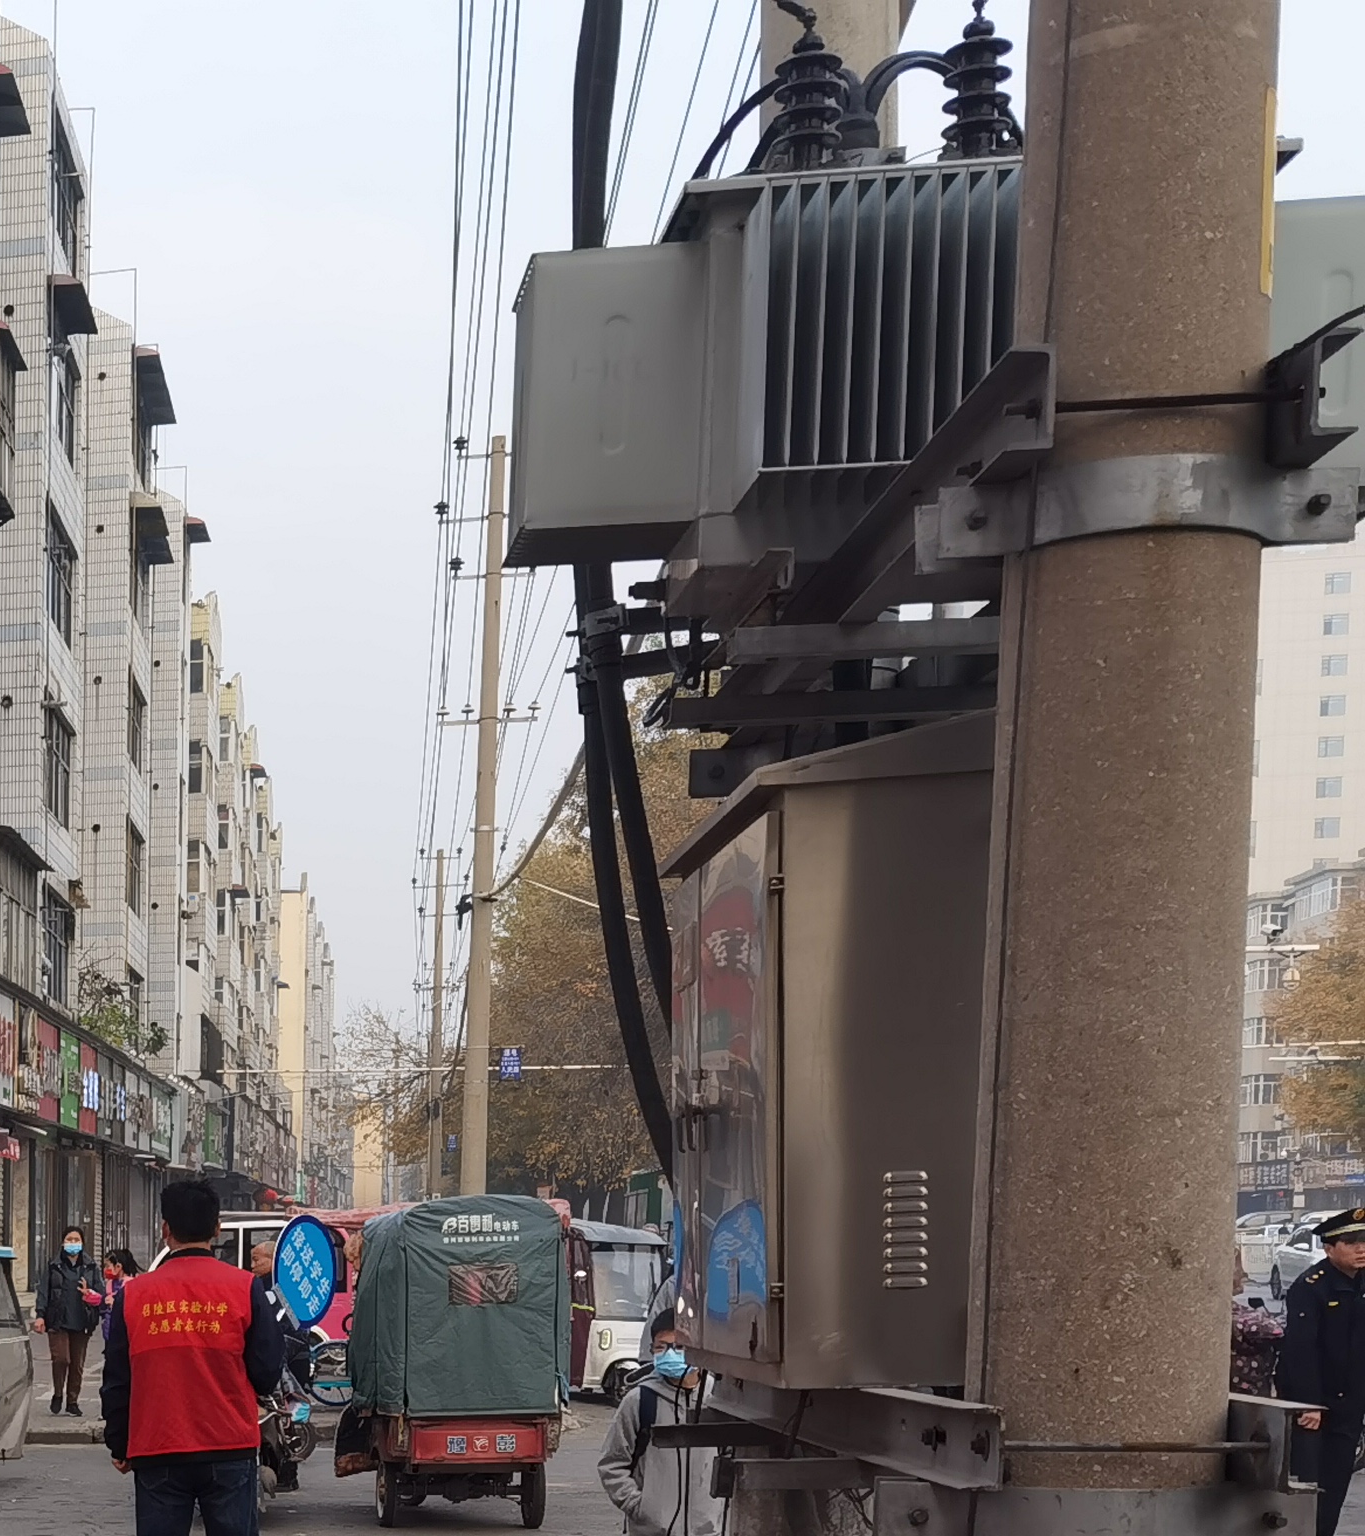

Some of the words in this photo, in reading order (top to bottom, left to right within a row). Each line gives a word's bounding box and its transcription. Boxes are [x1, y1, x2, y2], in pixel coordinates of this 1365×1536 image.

[291, 1225, 330, 1300] 接送学生
[142, 1299, 228, 1317] 召陵区实验小学
[148, 1317, 222, 1335] 志愿者在行动
